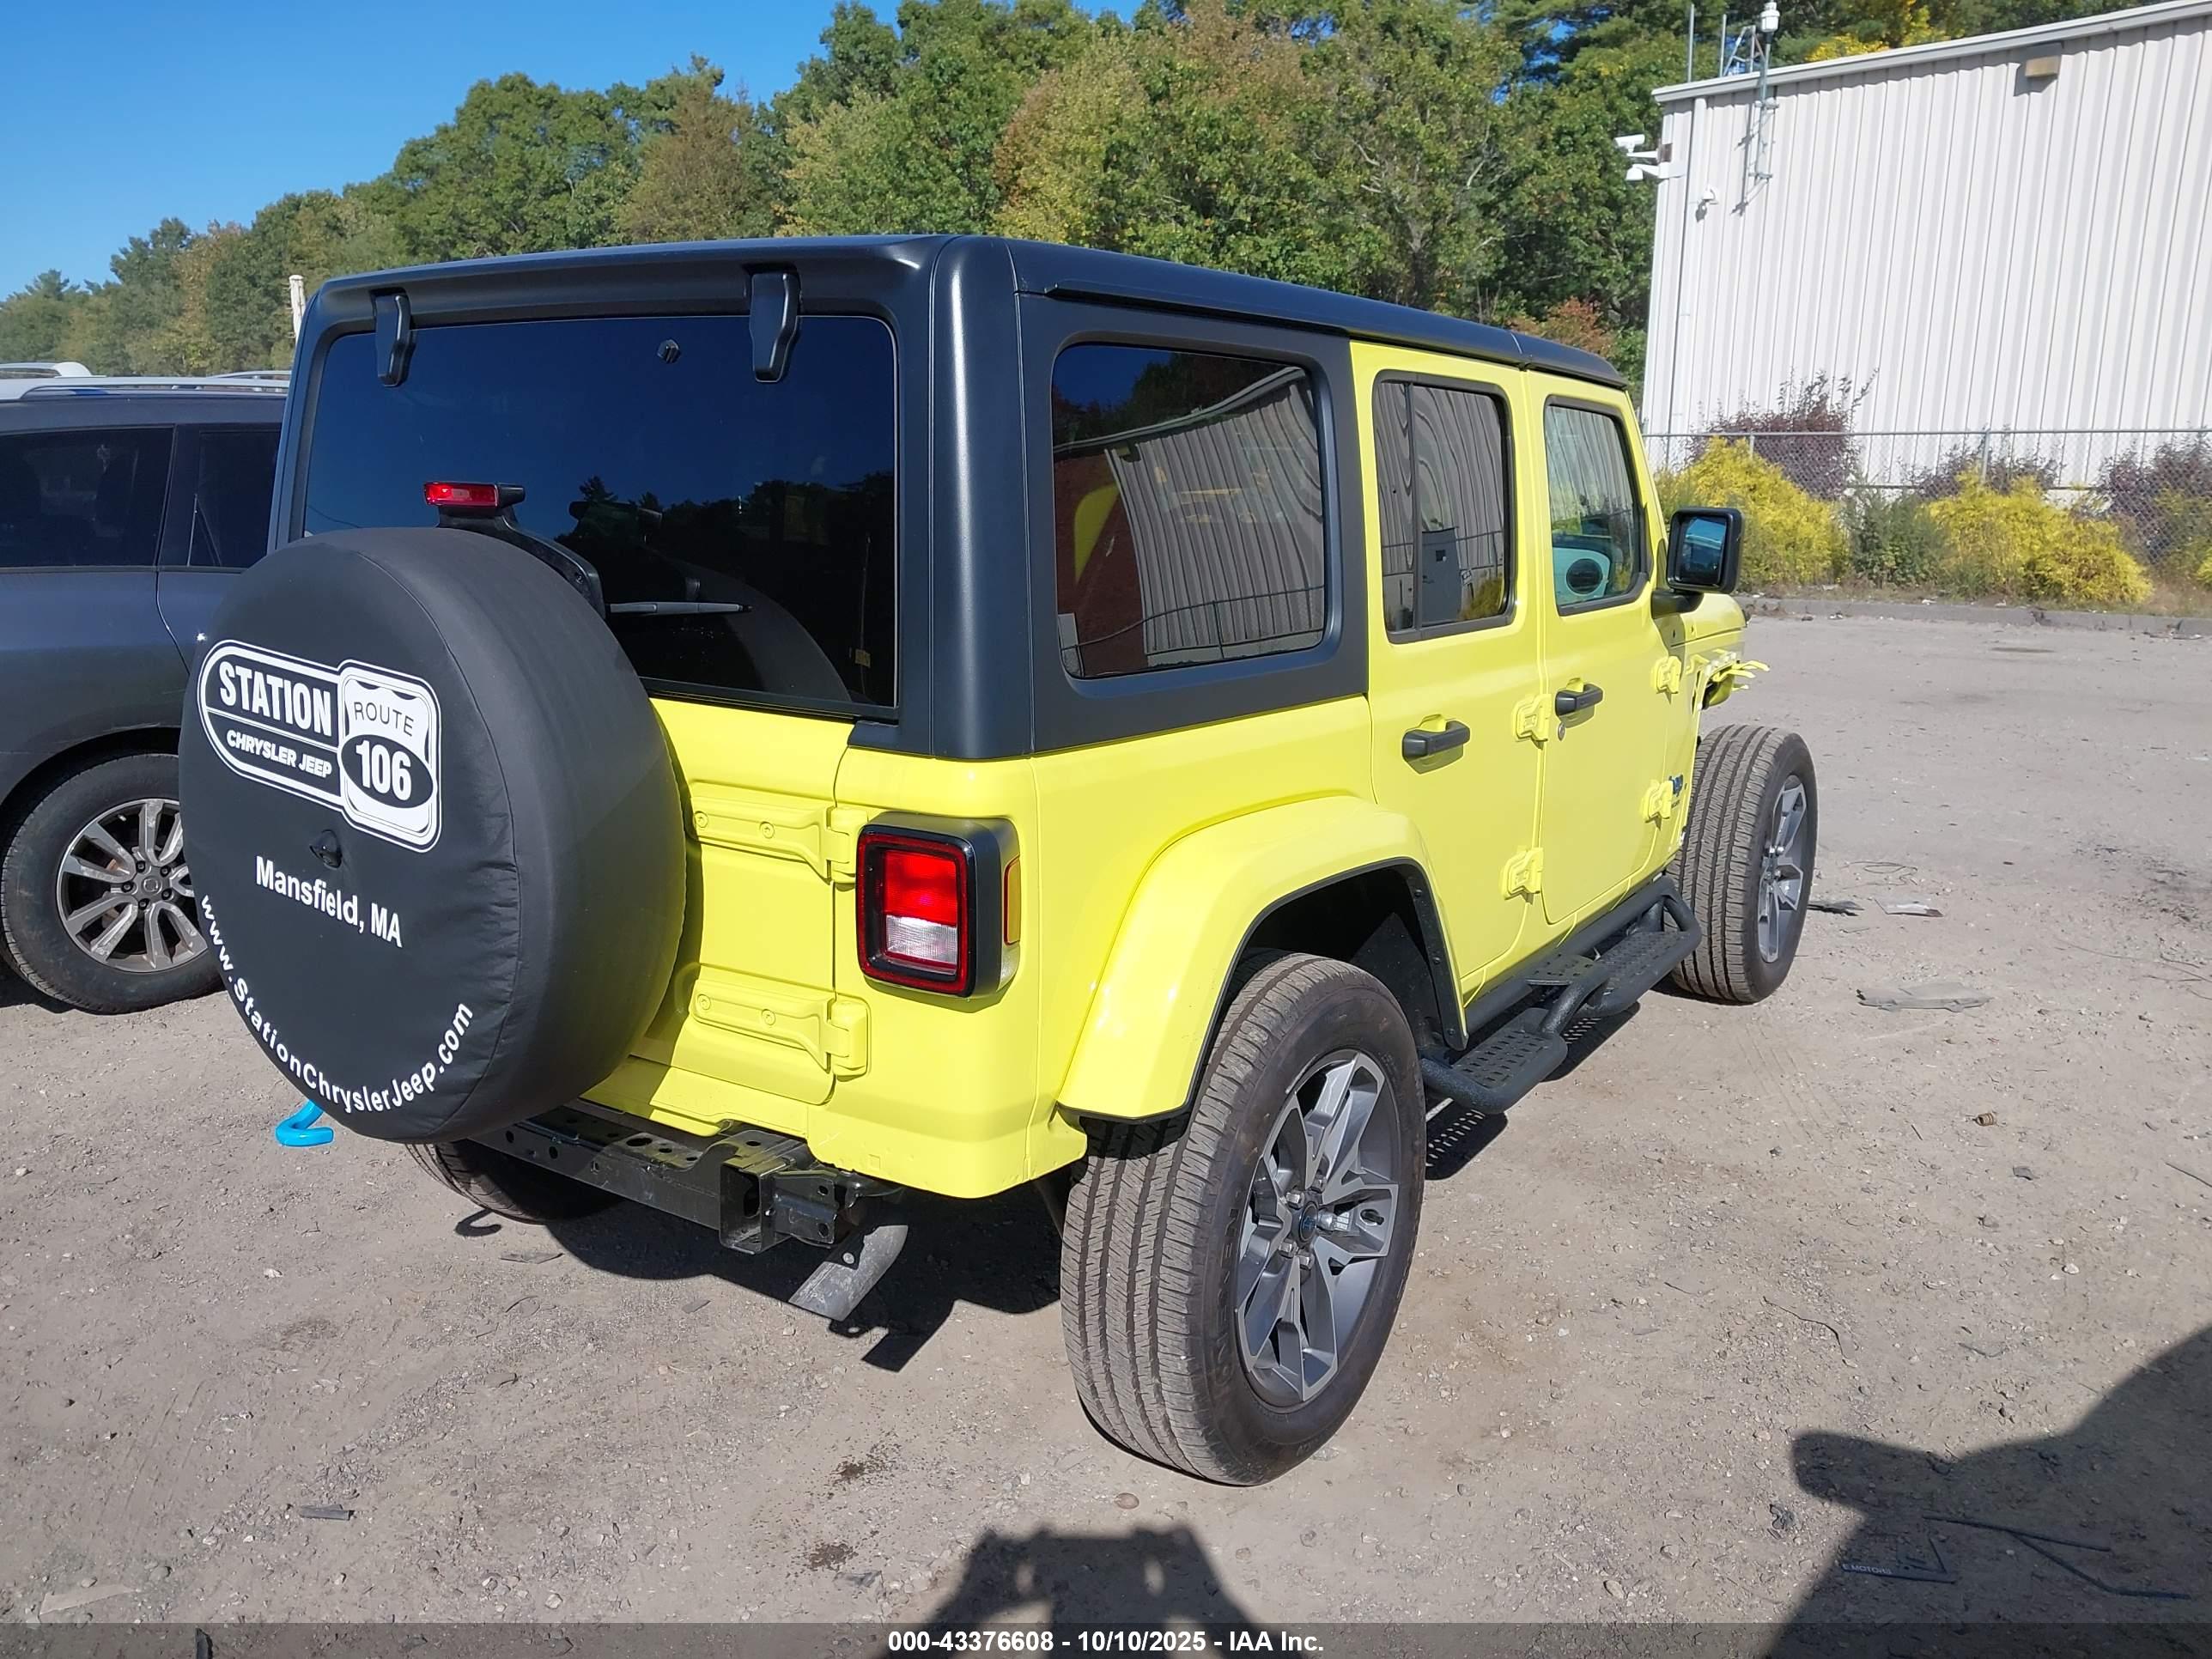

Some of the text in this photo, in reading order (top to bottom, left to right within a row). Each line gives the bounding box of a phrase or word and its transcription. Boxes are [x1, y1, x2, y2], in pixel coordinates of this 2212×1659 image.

[219, 661, 332, 737] STATION
[354, 702, 414, 737] ROUTE
[226, 729, 332, 778] CHRYSLER JEEP
[356, 739, 412, 801] 106
[256, 855, 403, 948] Mansfield, MA
[201, 895, 473, 1114] www.StationChryslerJeep.com
